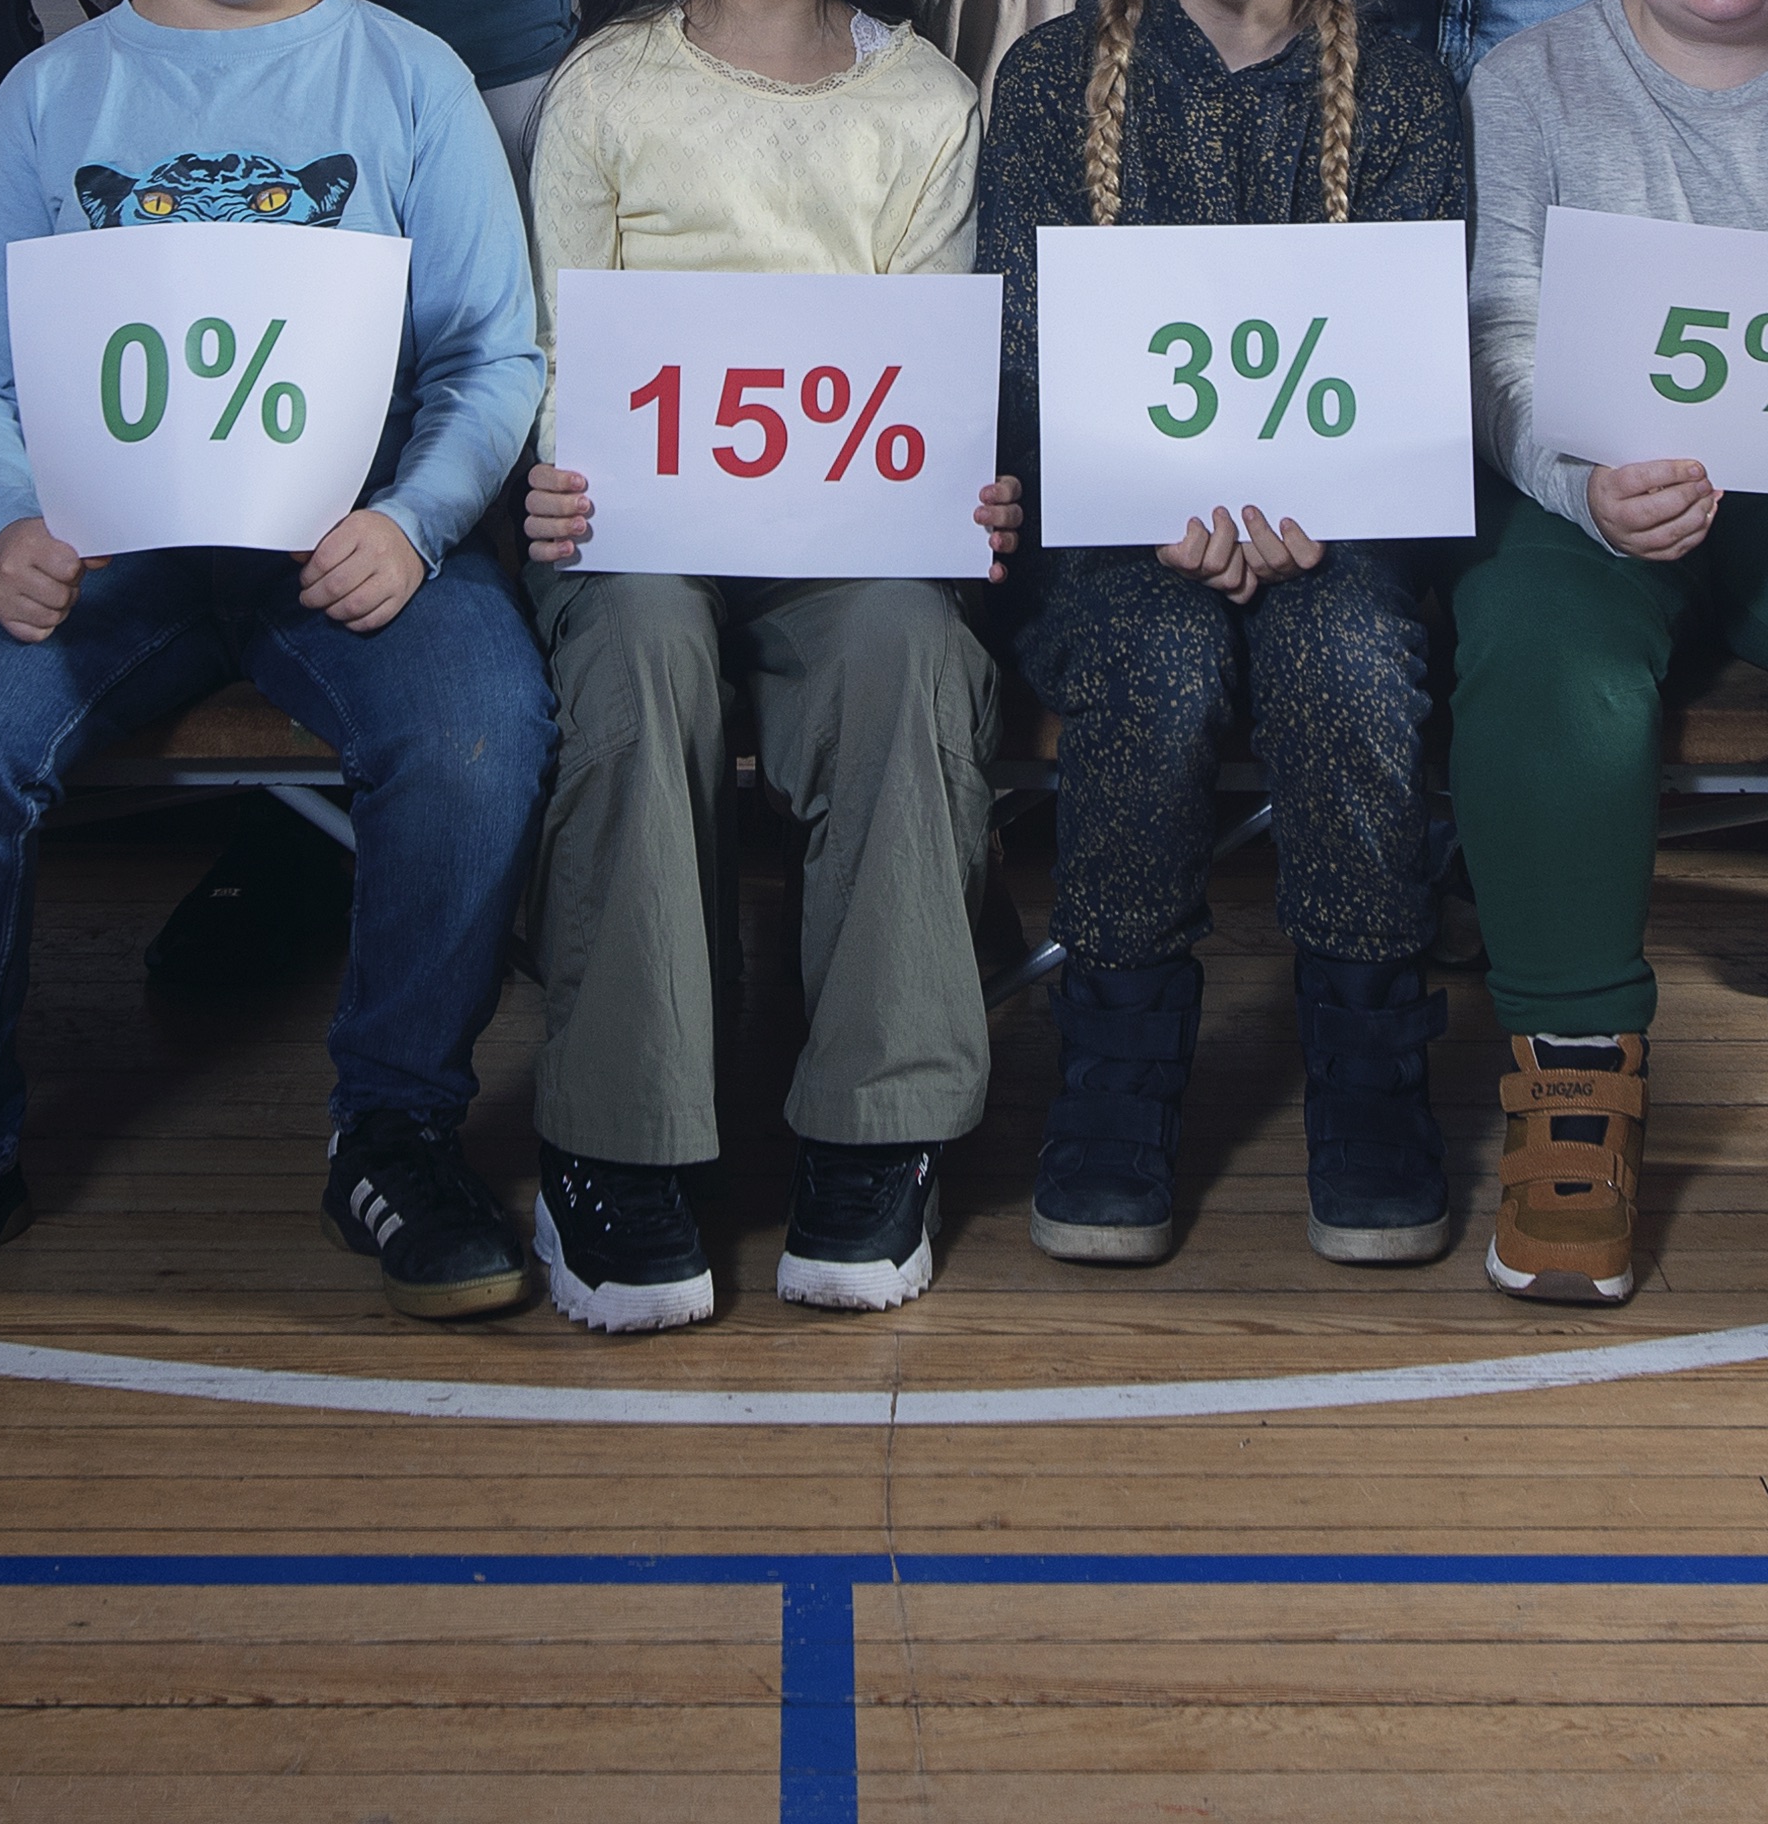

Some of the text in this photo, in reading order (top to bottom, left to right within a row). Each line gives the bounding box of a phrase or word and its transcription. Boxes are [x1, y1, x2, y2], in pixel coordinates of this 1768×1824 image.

[100, 319, 305, 444] 0%
[630, 365, 925, 481] 15%
[1148, 319, 1355, 439] 3%
[1546, 1081, 1593, 1098] ZIGZAG
